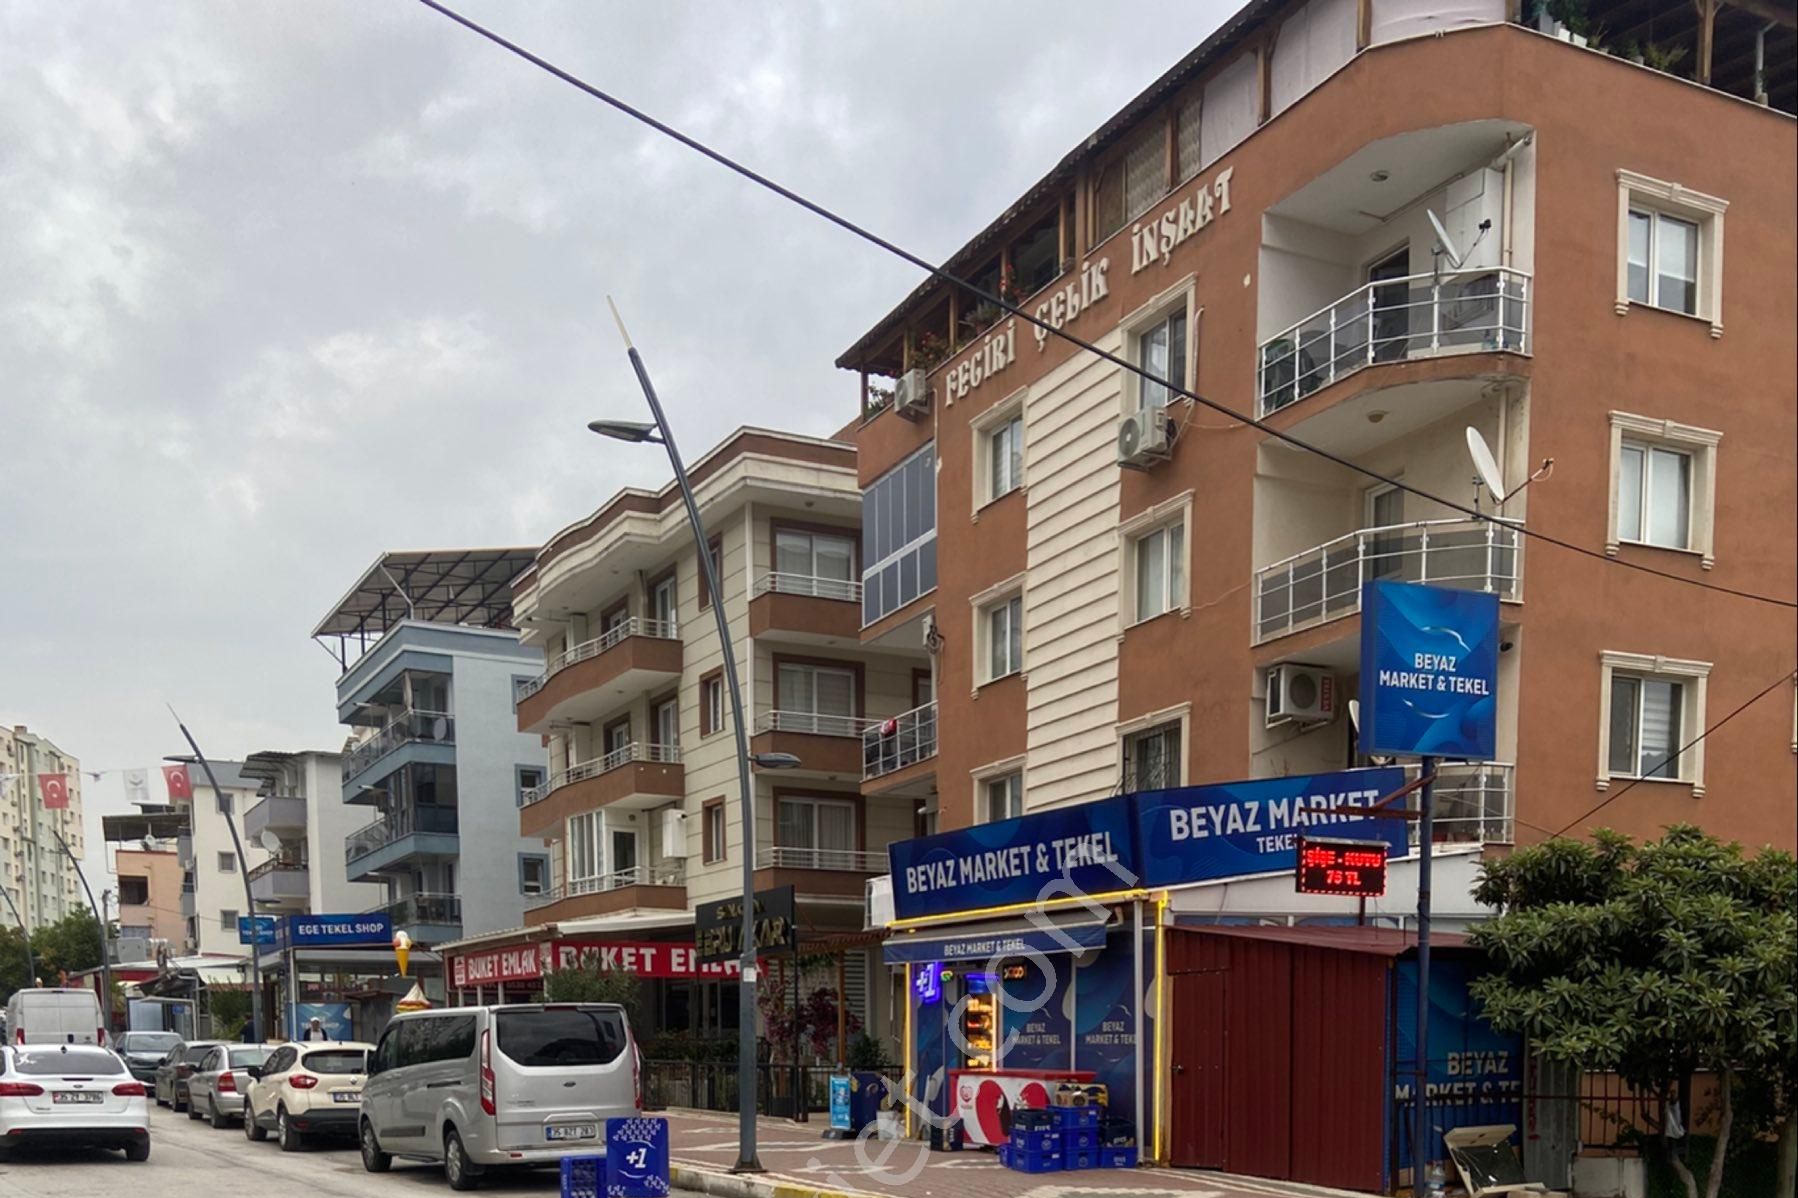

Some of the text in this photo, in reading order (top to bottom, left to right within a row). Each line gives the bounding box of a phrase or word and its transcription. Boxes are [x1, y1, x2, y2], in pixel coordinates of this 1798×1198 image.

[1033, 257, 1110, 352] ÇELİK
[1131, 165, 1234, 275] İNŞAAT
[1414, 652, 1457, 672] BEYAZ
[1379, 670, 1490, 696] MARKET & TEKEL
[1170, 789, 1379, 841] BEYAZ MARKET
[1256, 833, 1298, 854] TEKE
[906, 831, 1119, 894] BEYAZ MARKET & TEKEL
[298, 925, 319, 935] EGE
[321, 923, 354, 934] TEKEL
[356, 922, 384, 933] SHOP
[944, 944, 967, 956] BEYAZ
[966, 940, 996, 952] MARKET
[468, 955, 500, 980] BUKET
[502, 949, 537, 977] EMLAK
[1120, 1033, 1137, 1045] TEKE
[1447, 1052, 1509, 1075] BEYAZ
[1395, 1083, 1476, 1107] MRKET
[625, 1148, 648, 1169] +1
